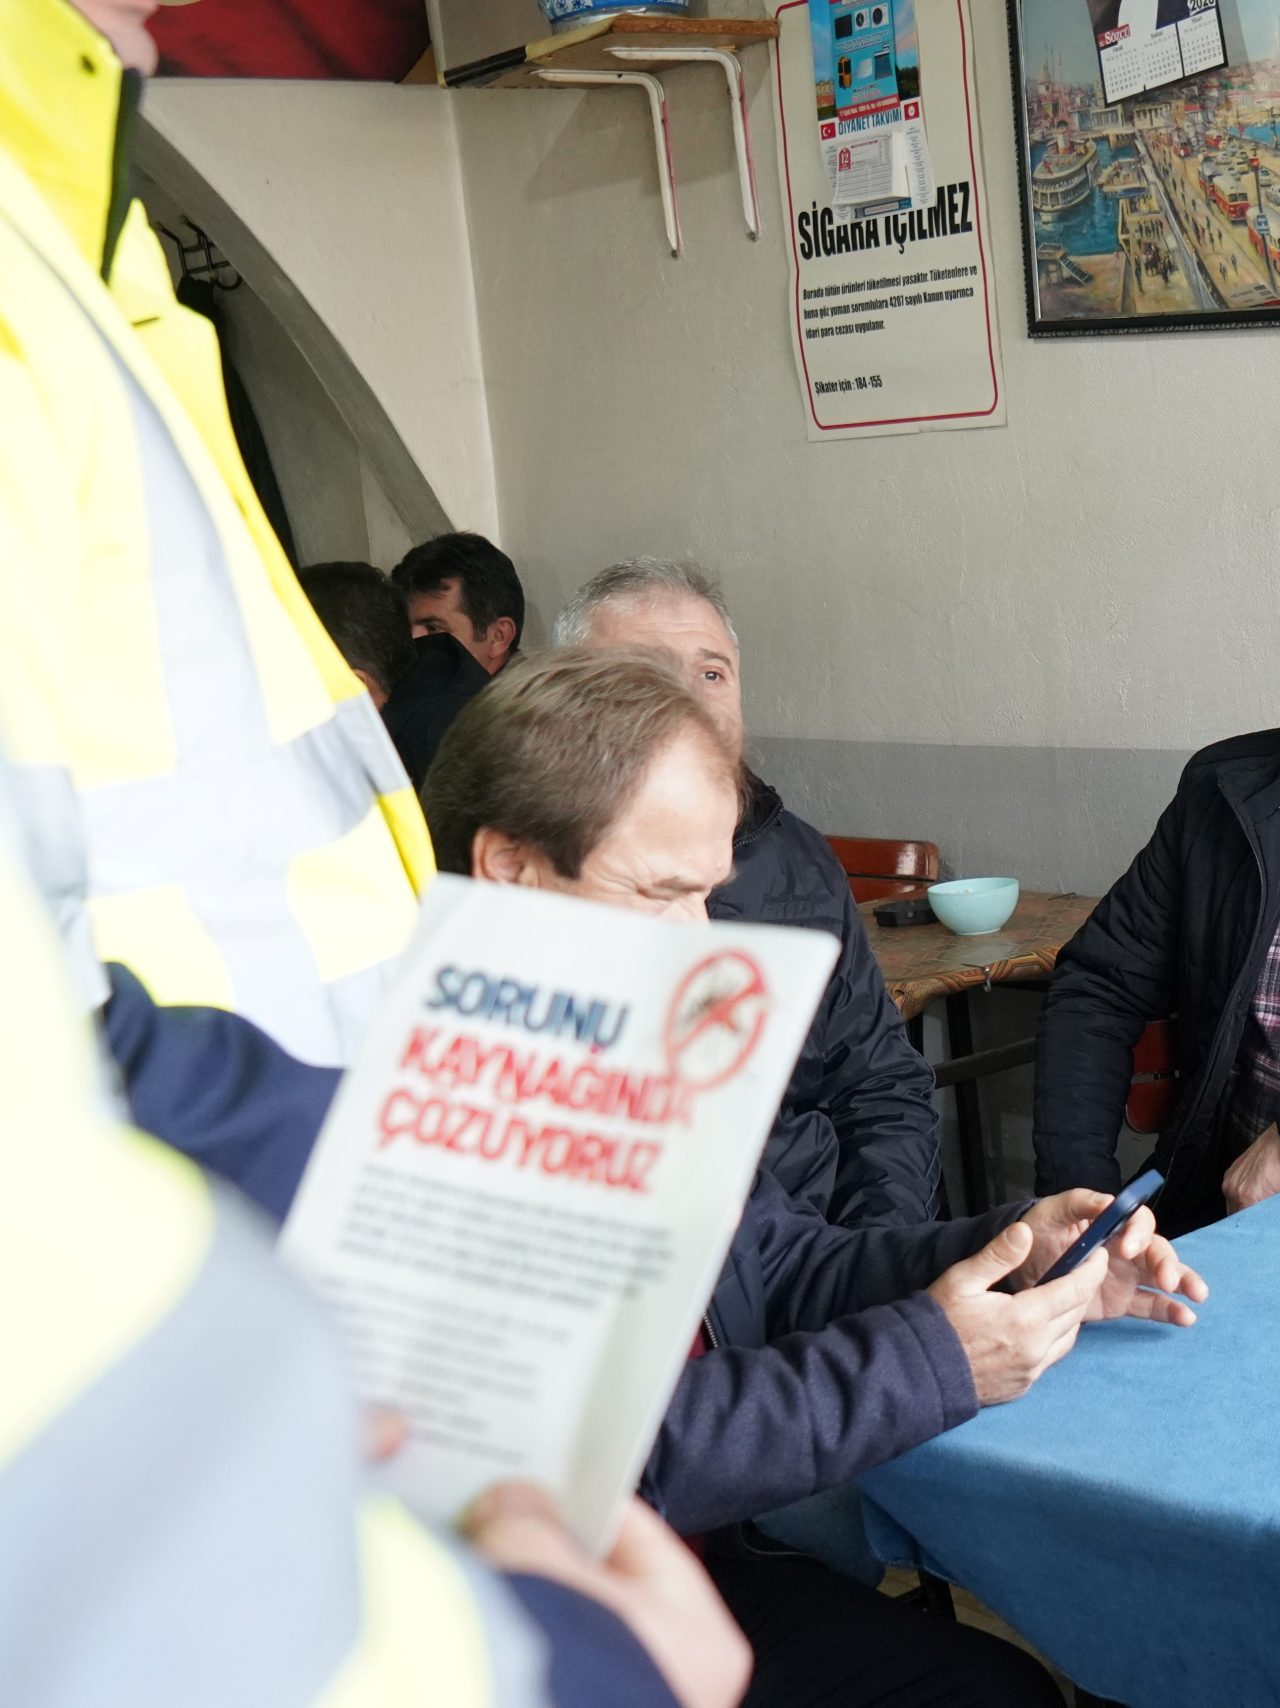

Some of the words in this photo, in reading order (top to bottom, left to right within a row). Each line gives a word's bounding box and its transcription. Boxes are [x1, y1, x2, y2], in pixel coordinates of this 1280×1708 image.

[838, 115, 870, 135] DİYANET
[803, 287, 824, 300] Burada
[825, 284, 840, 297] tütün
[841, 280, 866, 295] ürünleri
[929, 266, 968, 281] Tüketenlere
[969, 265, 978, 276] ve
[803, 308, 818, 320] buna
[820, 305, 830, 319] göz
[830, 304, 850, 317] yuman
[851, 298, 889, 313] sorumlulara
[889, 295, 904, 308] 4207
[905, 292, 923, 306] sayılı
[923, 291, 944, 303] Kanun
[944, 287, 974, 302] uyarınca
[820, 326, 834, 338] para
[835, 323, 854, 336] cezası
[855, 376, 868, 390] 184
[425, 963, 630, 1049] SORUNU
